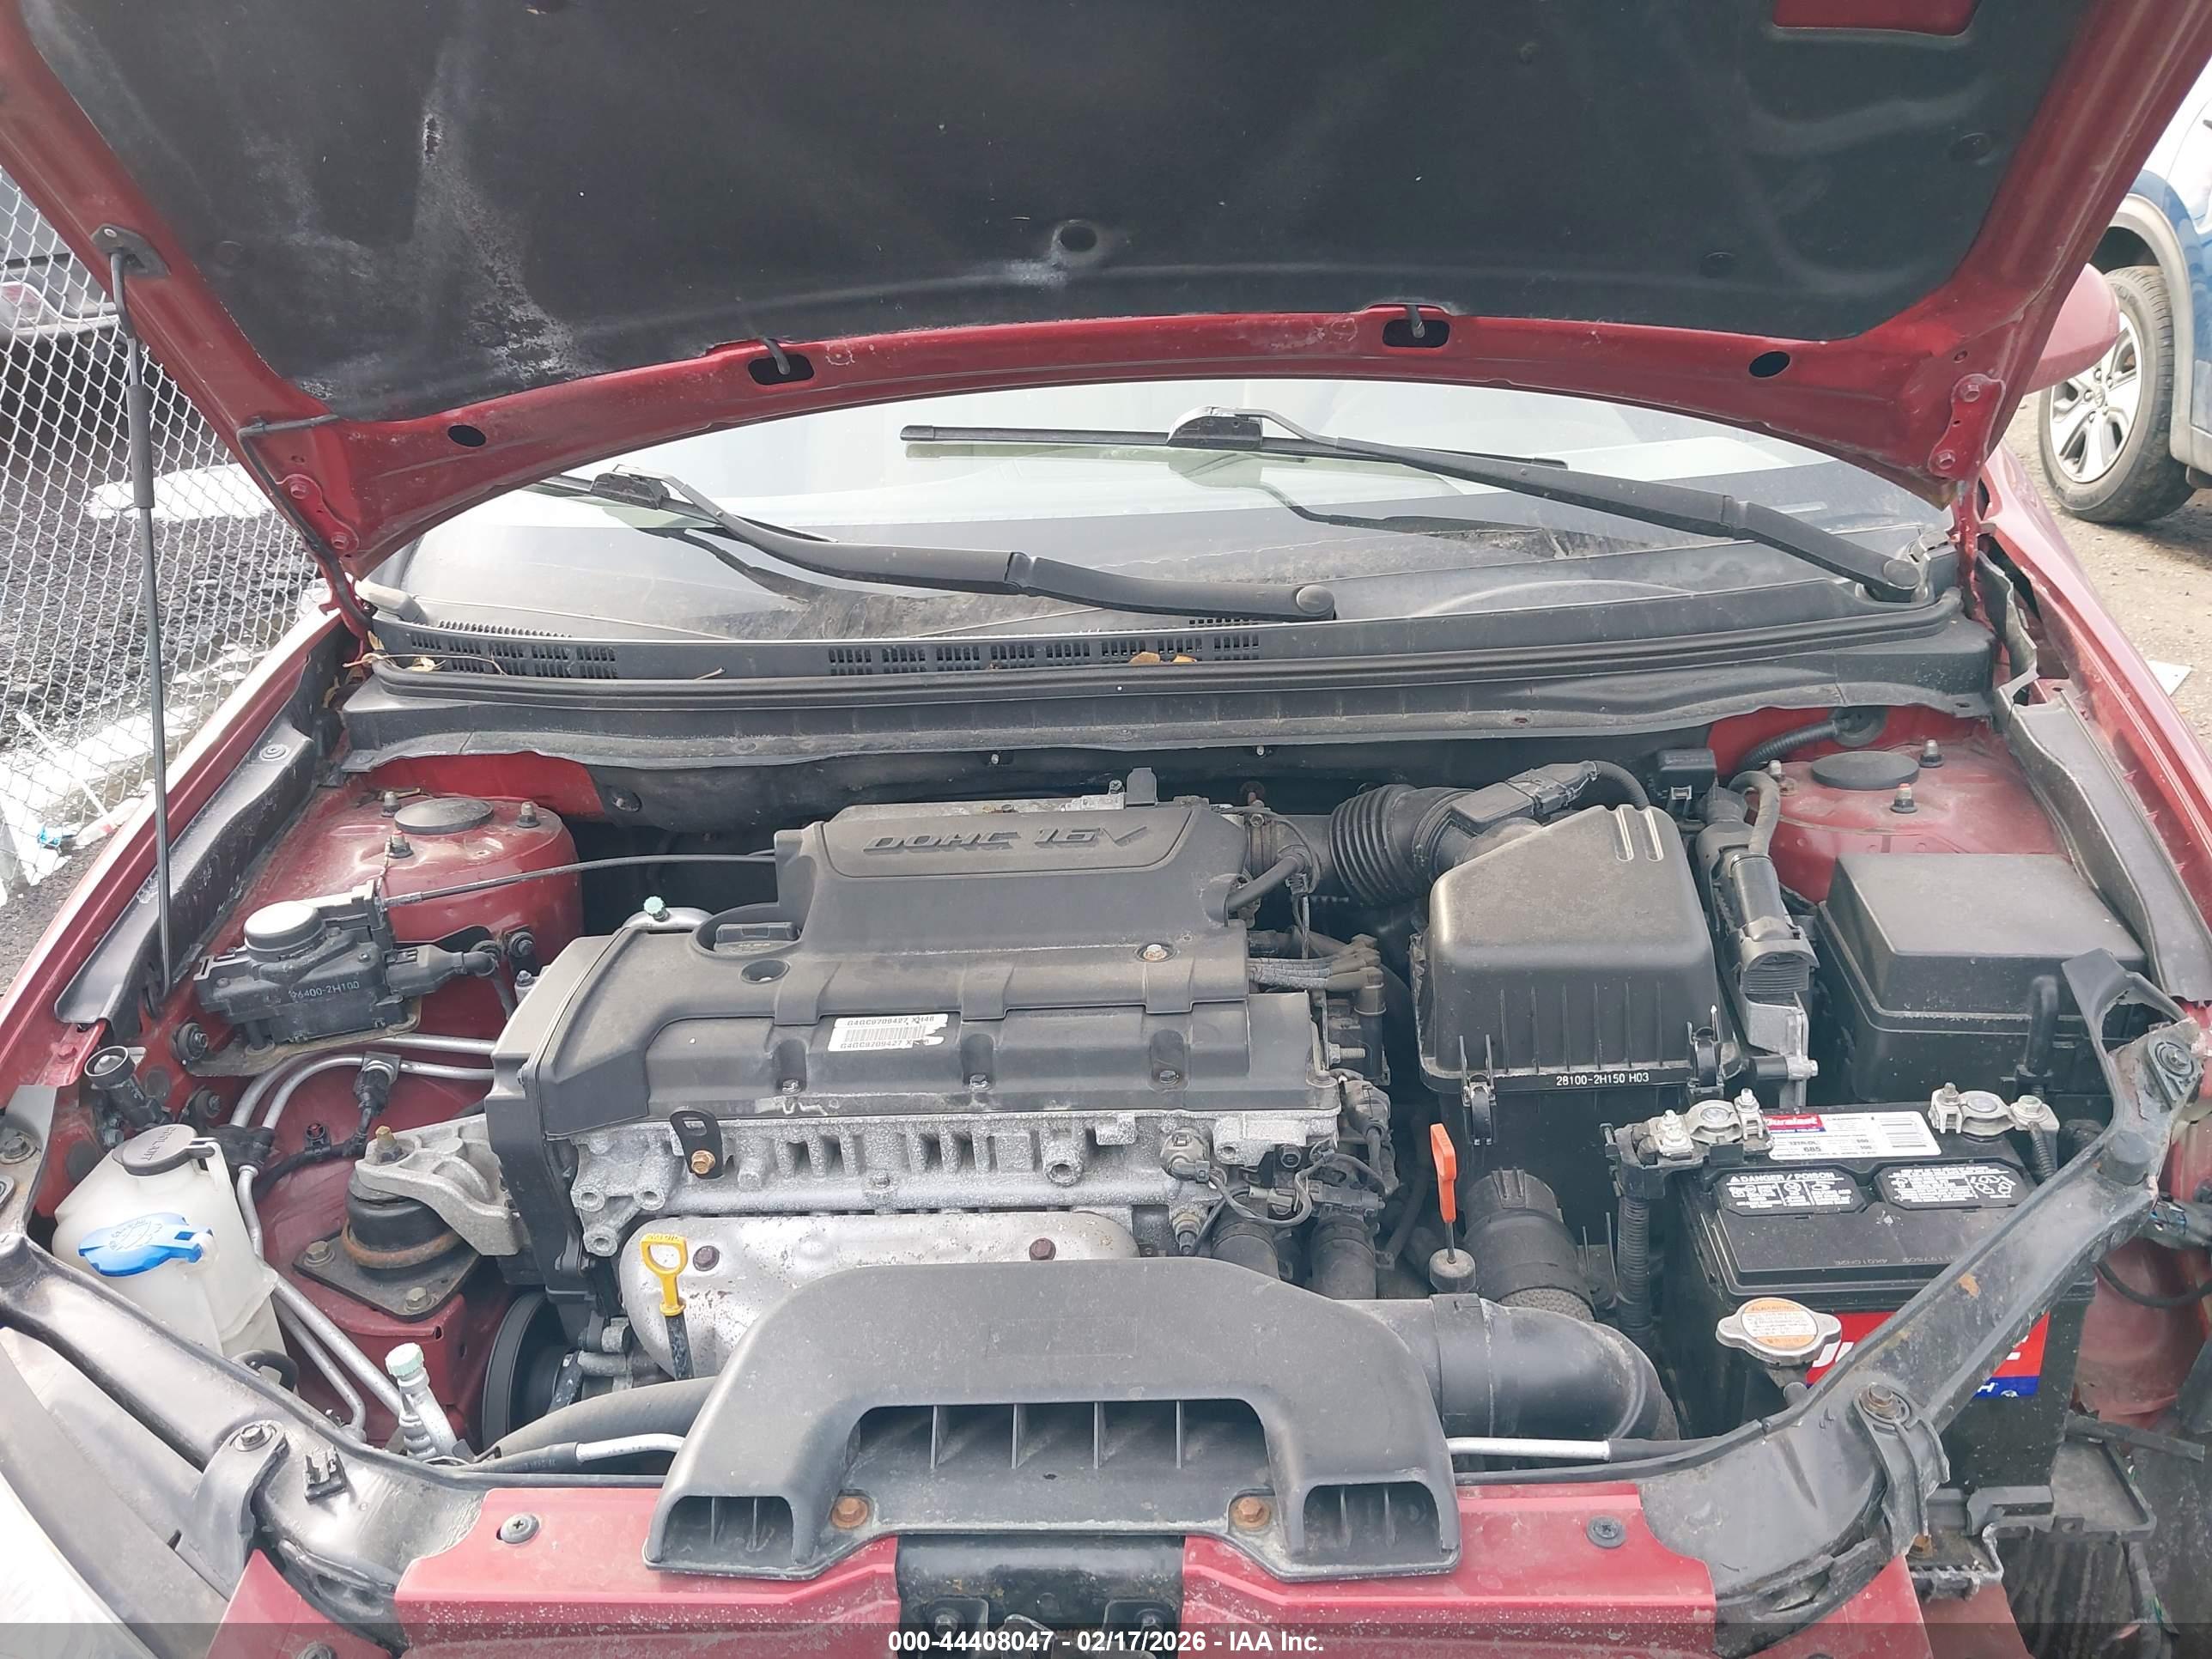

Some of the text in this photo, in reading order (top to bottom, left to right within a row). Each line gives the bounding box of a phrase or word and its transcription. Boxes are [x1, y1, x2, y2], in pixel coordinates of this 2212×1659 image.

[862, 824, 1147, 854] DOHC 16V
[1556, 1072, 1650, 1086] 28100-2H150 H03
[1740, 1174, 1785, 1182] DANGER
[1794, 1172, 1836, 1181] POISON
